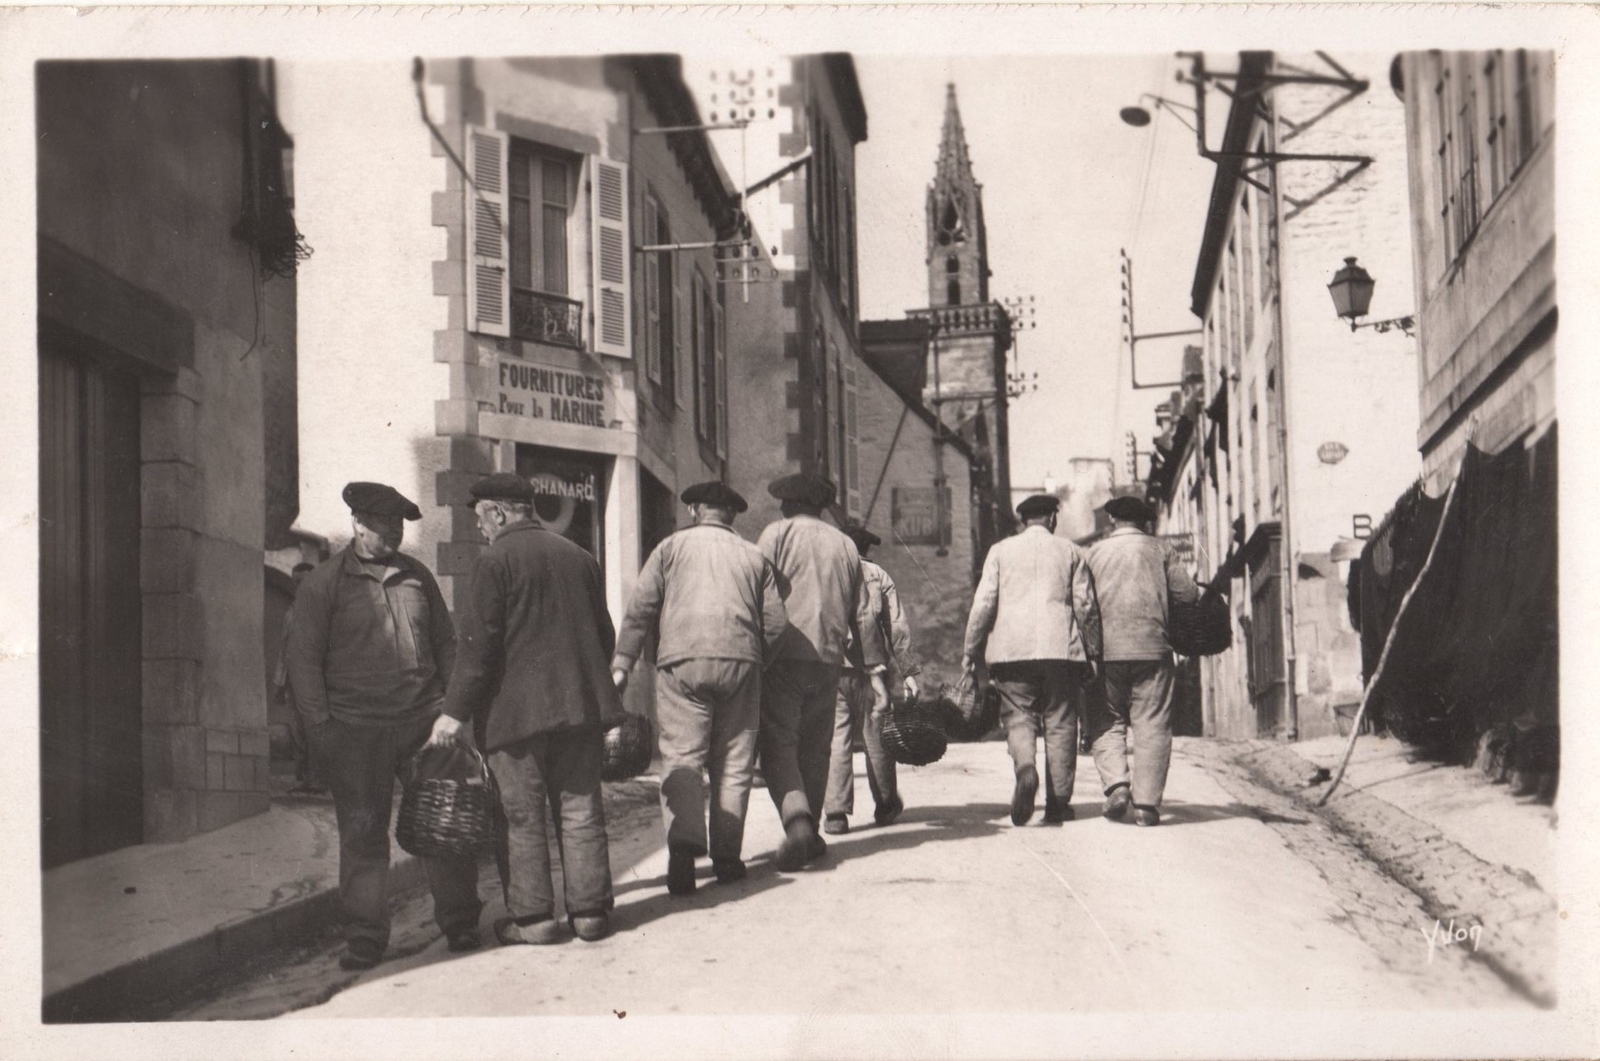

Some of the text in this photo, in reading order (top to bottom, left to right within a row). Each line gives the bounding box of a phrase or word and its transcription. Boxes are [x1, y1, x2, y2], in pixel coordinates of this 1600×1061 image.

[499, 361, 604, 401] FOURNITURES
[498, 392, 524, 416] Pour
[550, 397, 606, 429] MARINE
